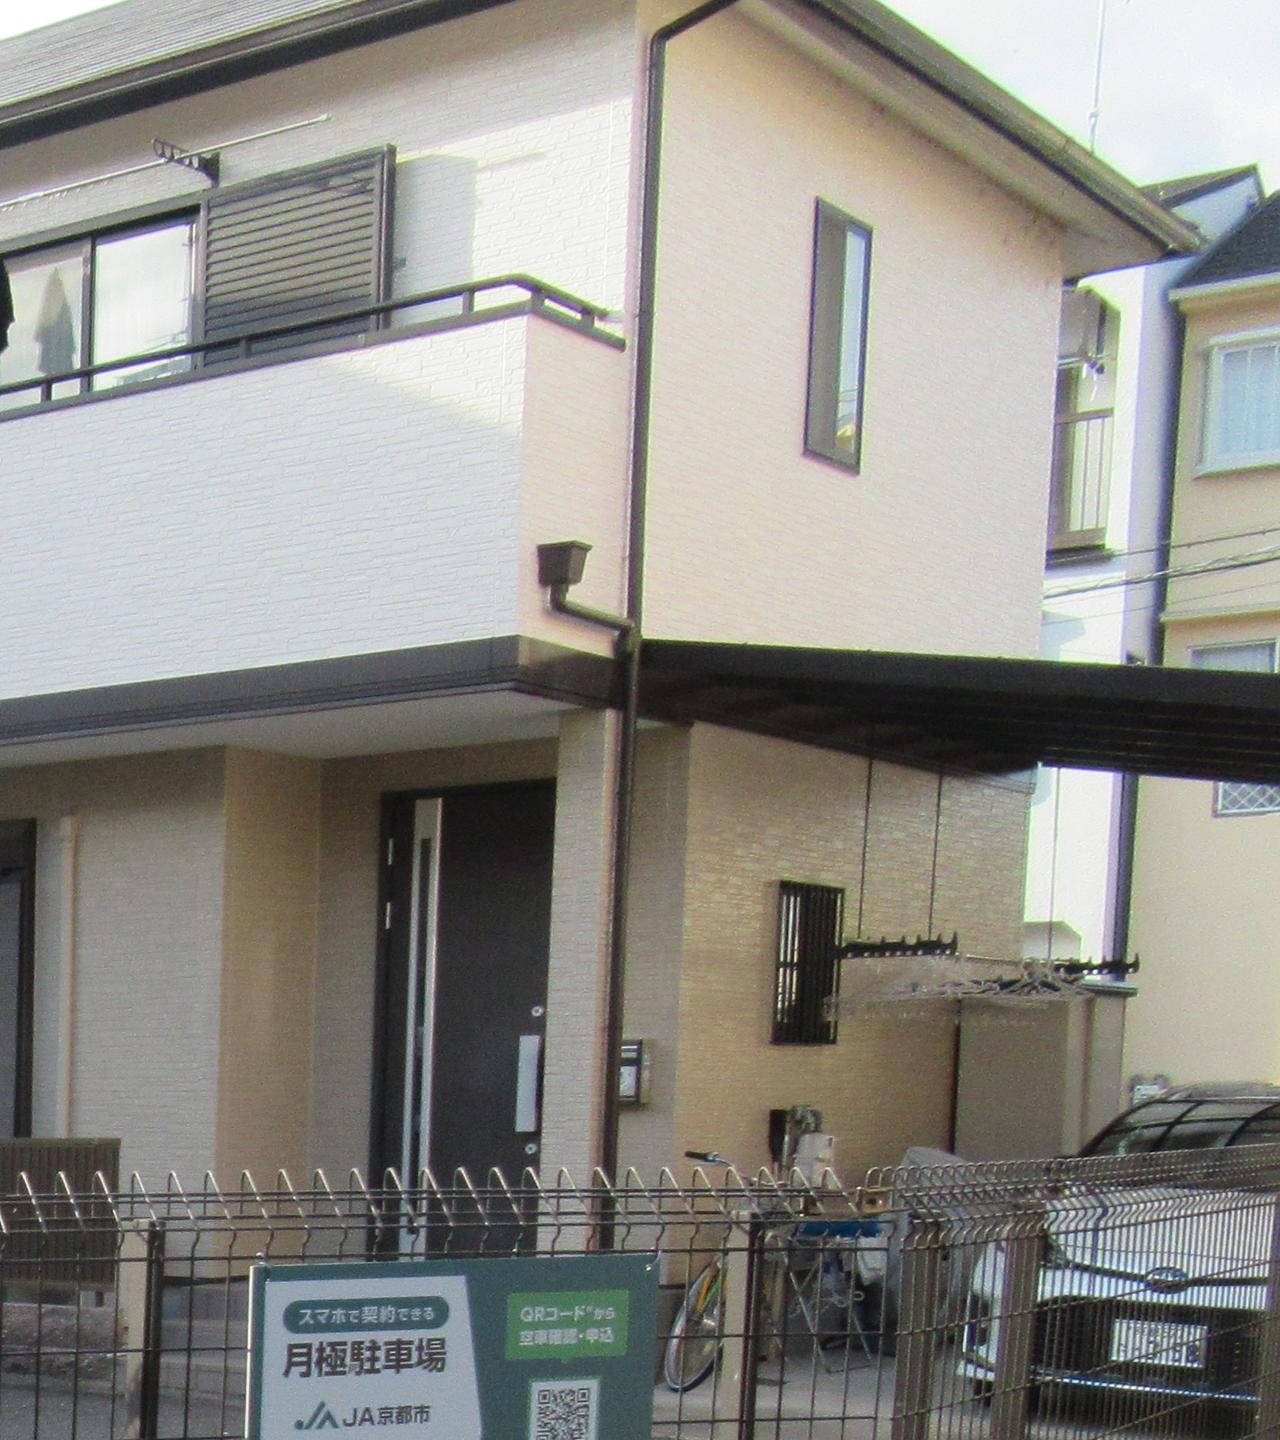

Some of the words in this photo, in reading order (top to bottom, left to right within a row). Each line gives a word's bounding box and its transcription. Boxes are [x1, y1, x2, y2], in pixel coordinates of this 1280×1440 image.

[298, 1304, 435, 1325] スマホで契約できる
[282, 1337, 447, 1378] 月極駐車場
[342, 1404, 431, 1428] JA京都市
